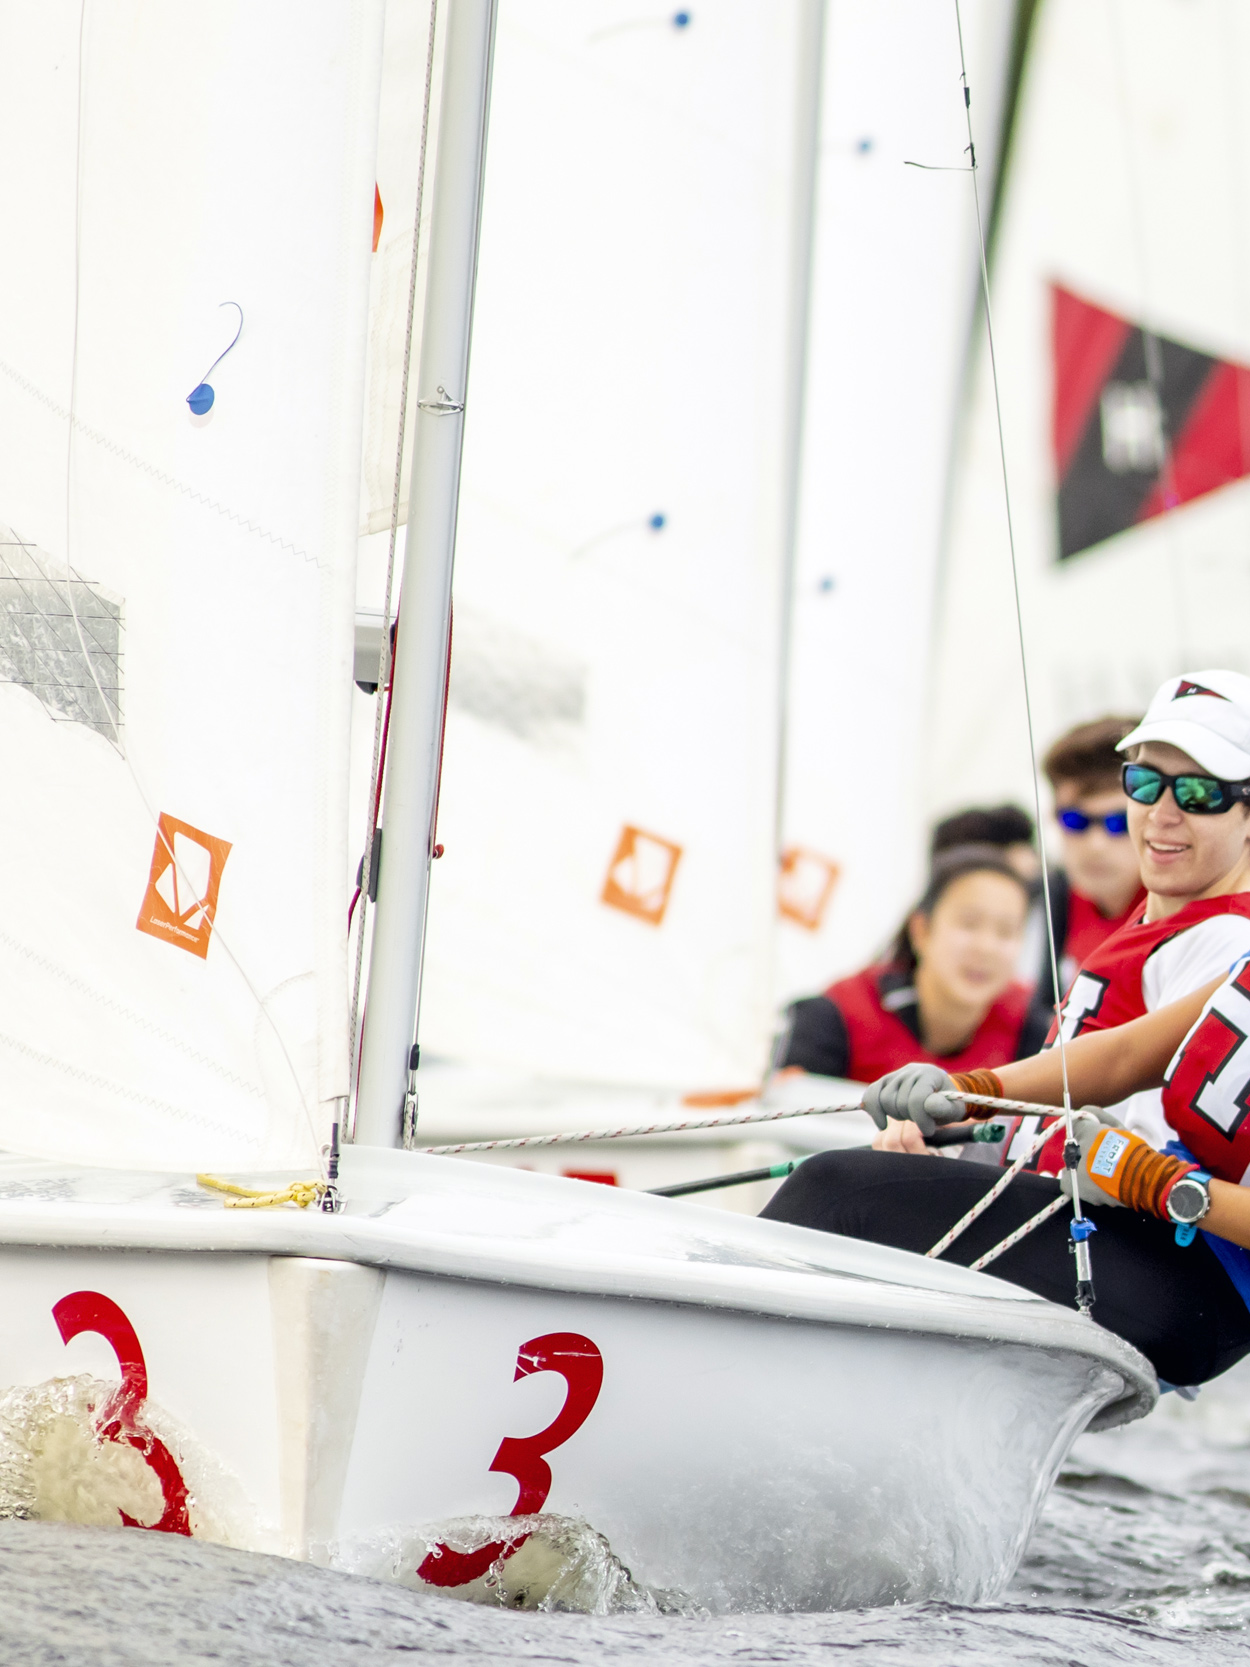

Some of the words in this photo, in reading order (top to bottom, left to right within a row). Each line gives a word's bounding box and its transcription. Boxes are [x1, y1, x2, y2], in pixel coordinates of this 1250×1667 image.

[150, 916, 200, 943] LaserPerformance
[1103, 1138, 1124, 1173] FROST
[51, 1290, 193, 1537] 3
[416, 1331, 605, 1588] 3
